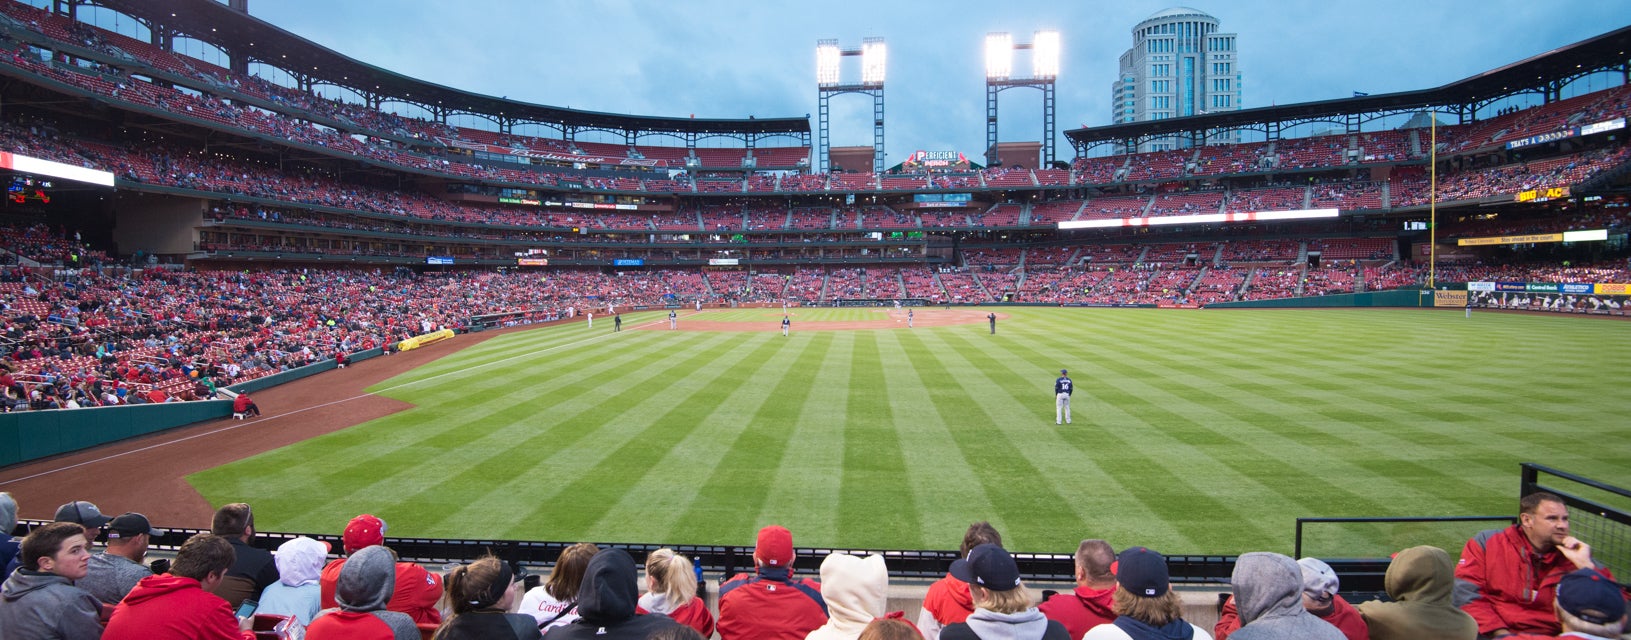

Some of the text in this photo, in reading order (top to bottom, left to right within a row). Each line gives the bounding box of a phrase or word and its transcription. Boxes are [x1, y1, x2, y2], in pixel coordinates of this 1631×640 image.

[509, 148, 605, 163] Budweiser
[916, 151, 957, 161] PERFICIENT
[1520, 187, 1562, 202] BIG MAC
